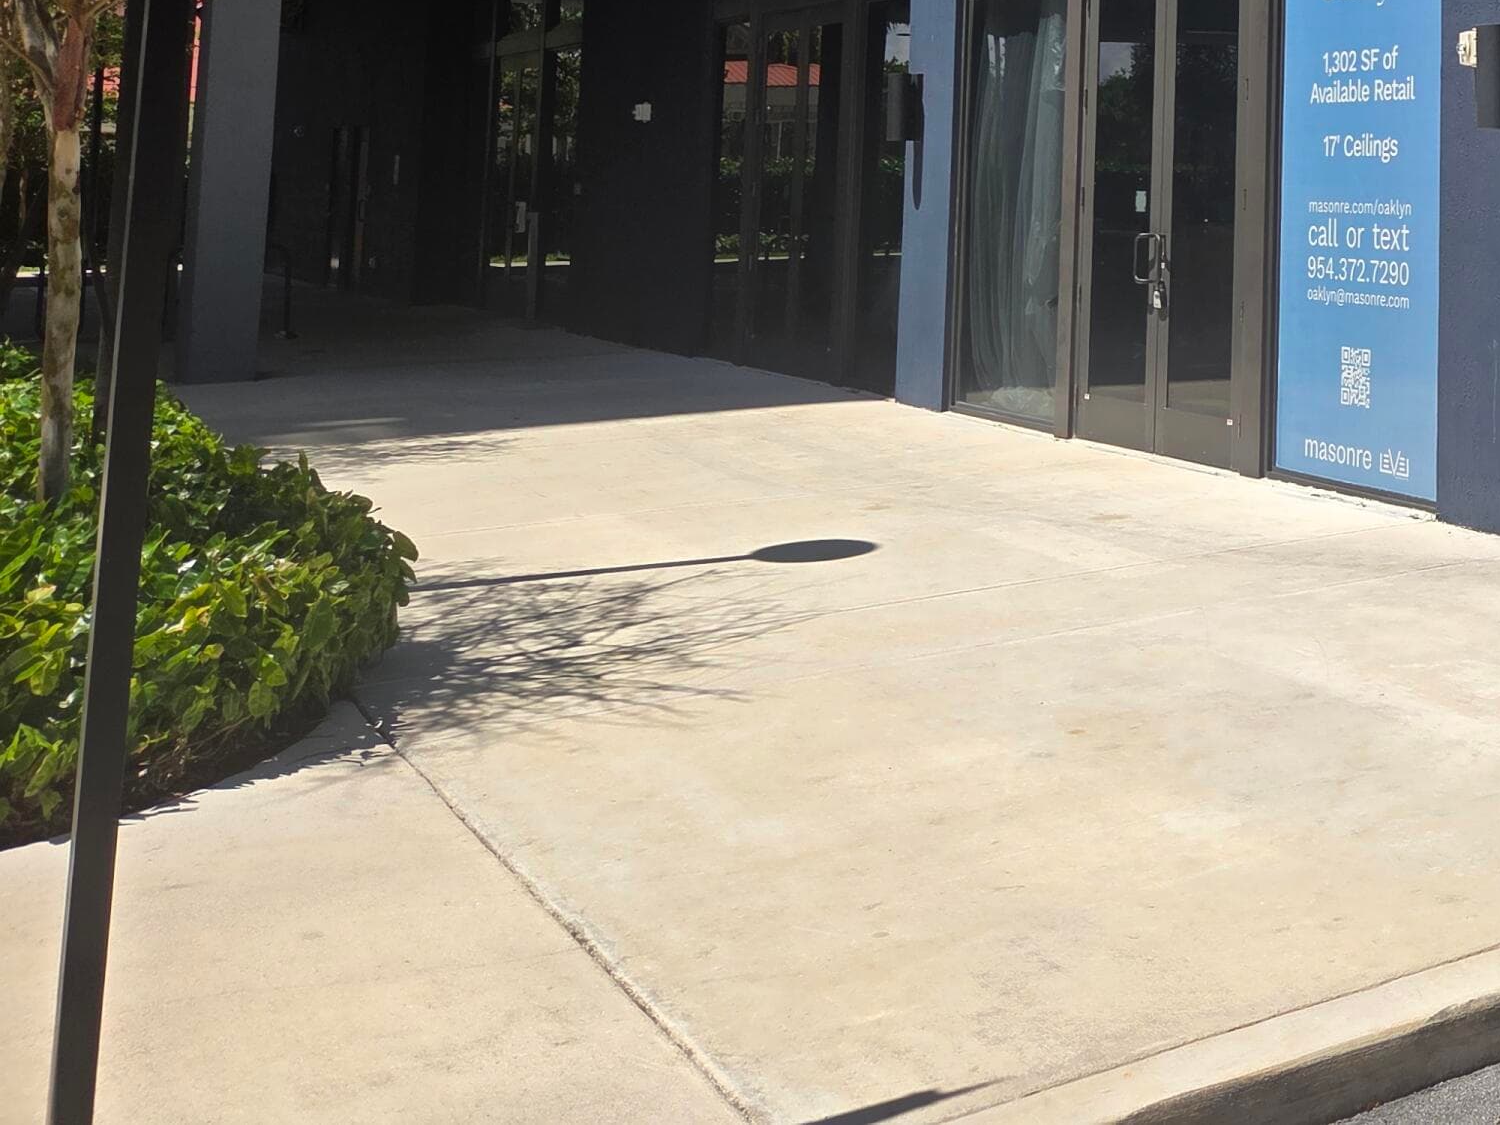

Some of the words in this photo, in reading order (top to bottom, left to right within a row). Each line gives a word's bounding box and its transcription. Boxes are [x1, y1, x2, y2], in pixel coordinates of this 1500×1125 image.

[1322, 50, 1357, 76] 1,302
[1361, 48, 1380, 72] SF
[1383, 45, 1399, 70] of
[1310, 80, 1370, 105] Available
[1374, 75, 1416, 103] Retail
[1323, 135, 1340, 158] 17'
[1343, 131, 1398, 164] Ceilings
[1308, 199, 1412, 219] masonre.com/oaklyn
[1308, 218, 1338, 248] call
[1346, 225, 1365, 249] or
[1372, 222, 1410, 252] text
[1307, 256, 1410, 286] 954.372.7290
[1307, 286, 1410, 309] oaklyn@masonre.com
[1304, 436, 1372, 470] masonre
